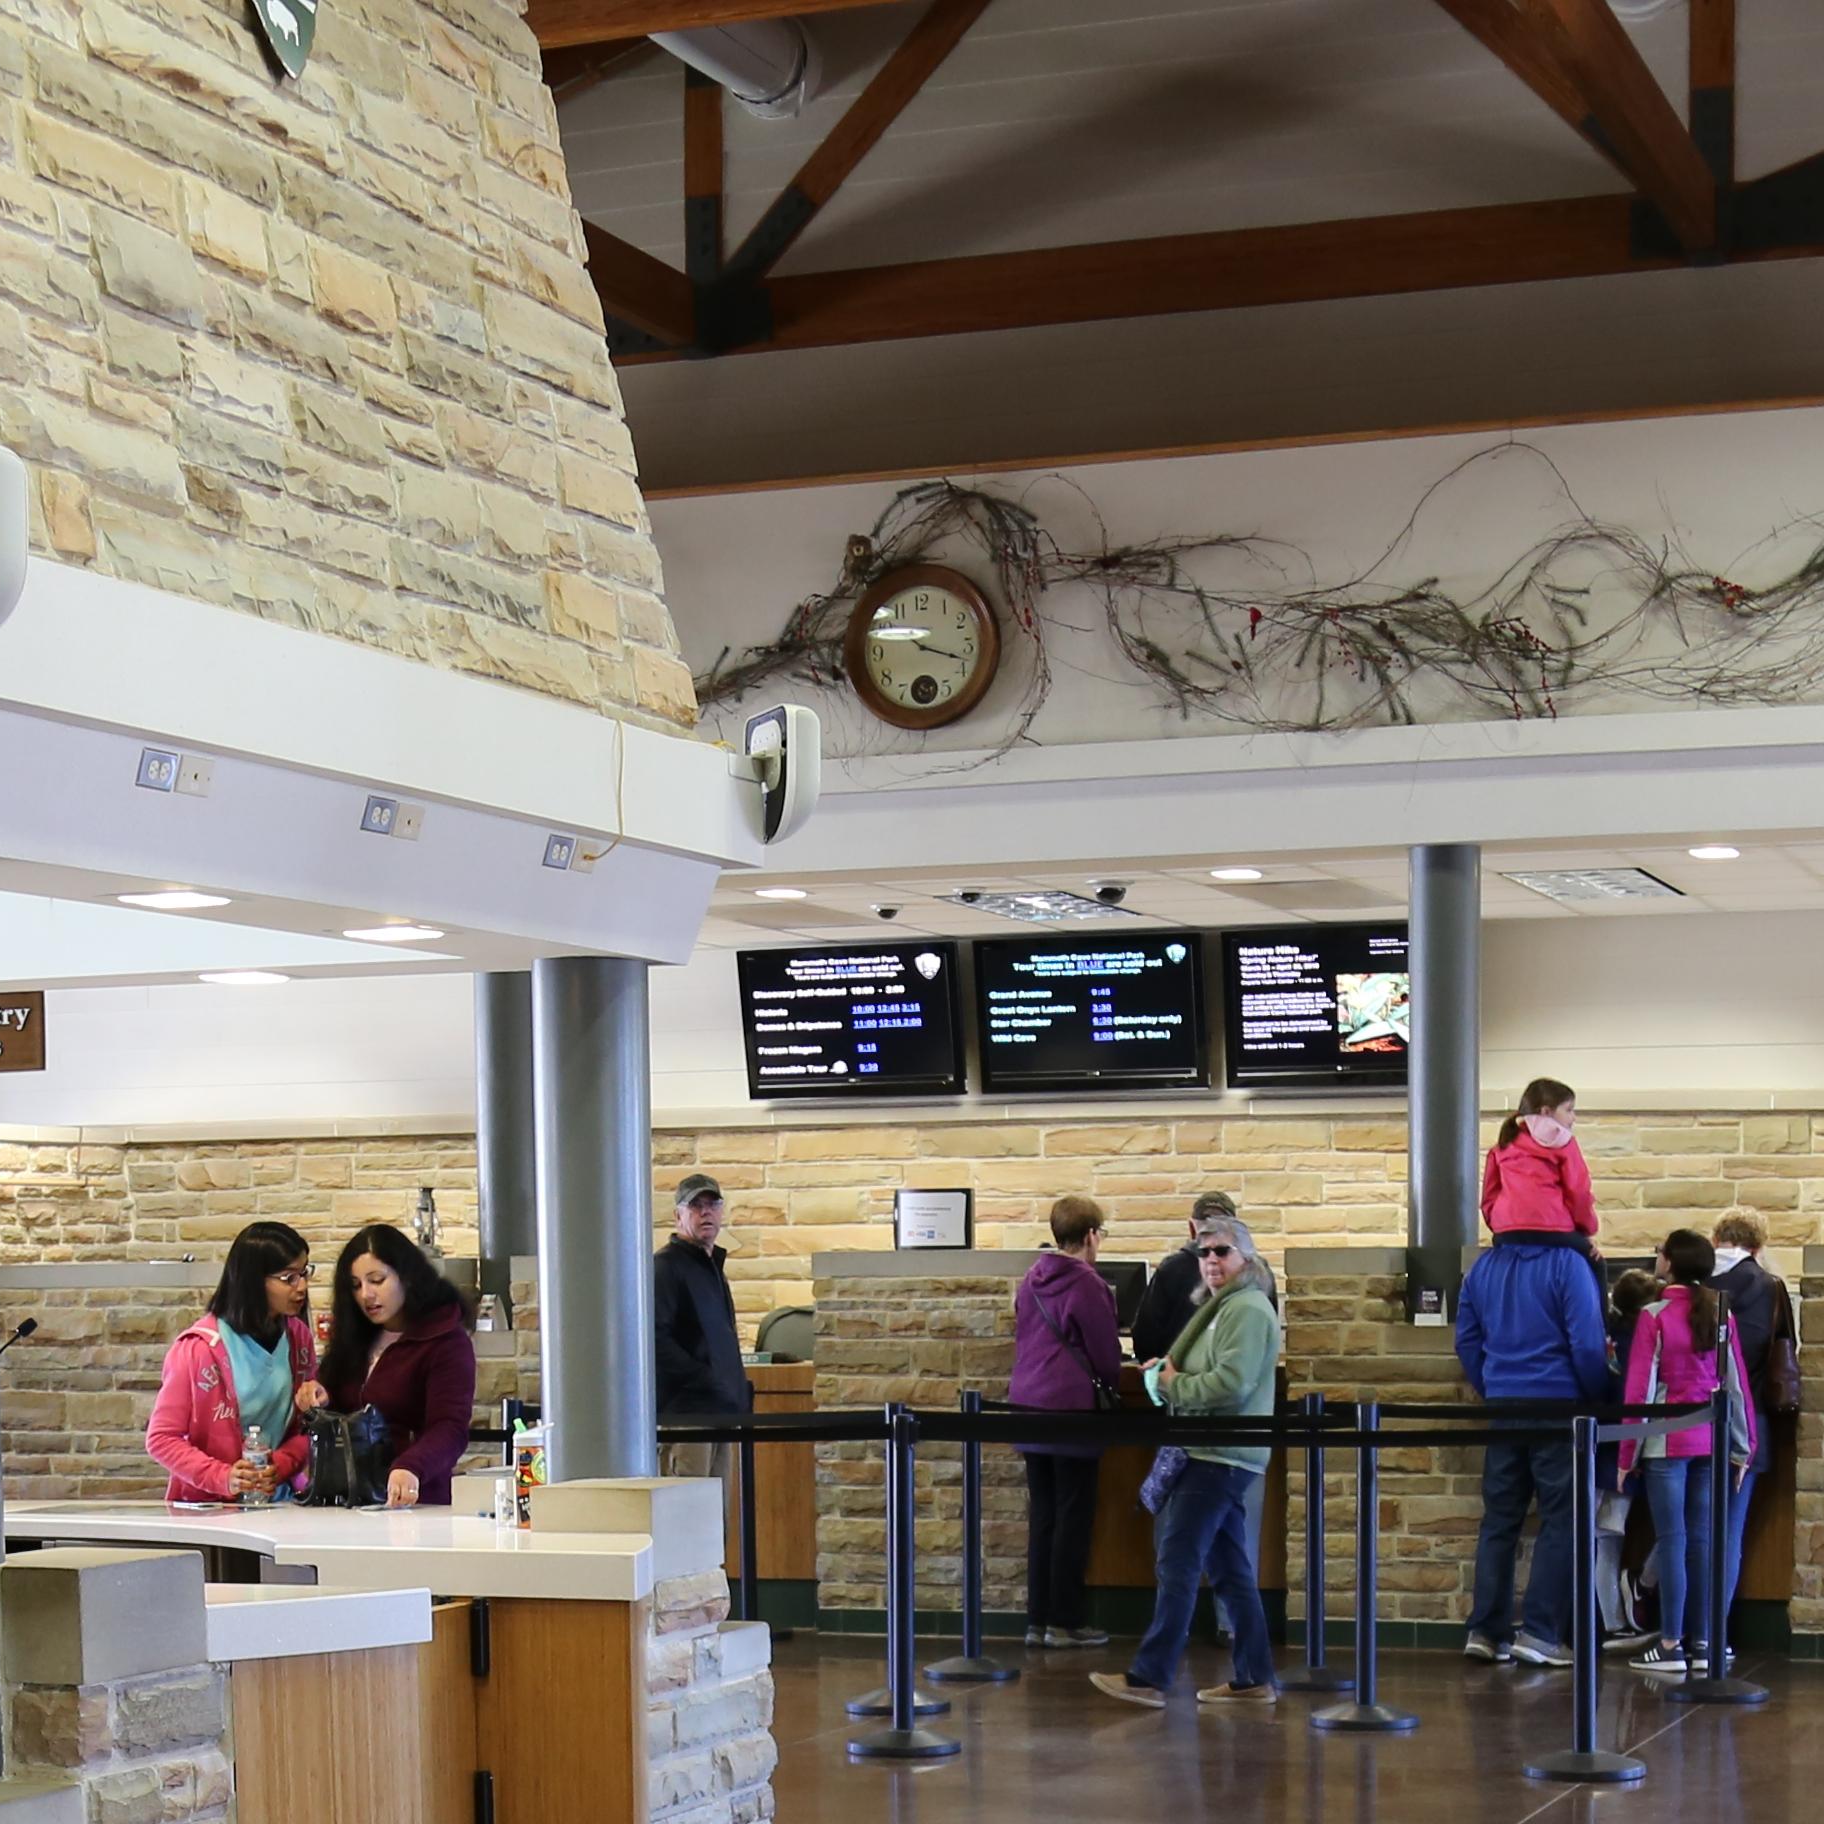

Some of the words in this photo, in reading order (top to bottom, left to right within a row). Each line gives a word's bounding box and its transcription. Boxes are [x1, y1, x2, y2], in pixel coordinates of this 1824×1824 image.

[915, 593, 928, 610] 12
[895, 603, 905, 619] 11
[956, 611, 966, 629] 2
[872, 645, 884, 661] 9
[880, 668, 892, 686] 8
[955, 661, 966, 677] 4
[898, 683, 908, 700] 7
[940, 680, 951, 697] 5
